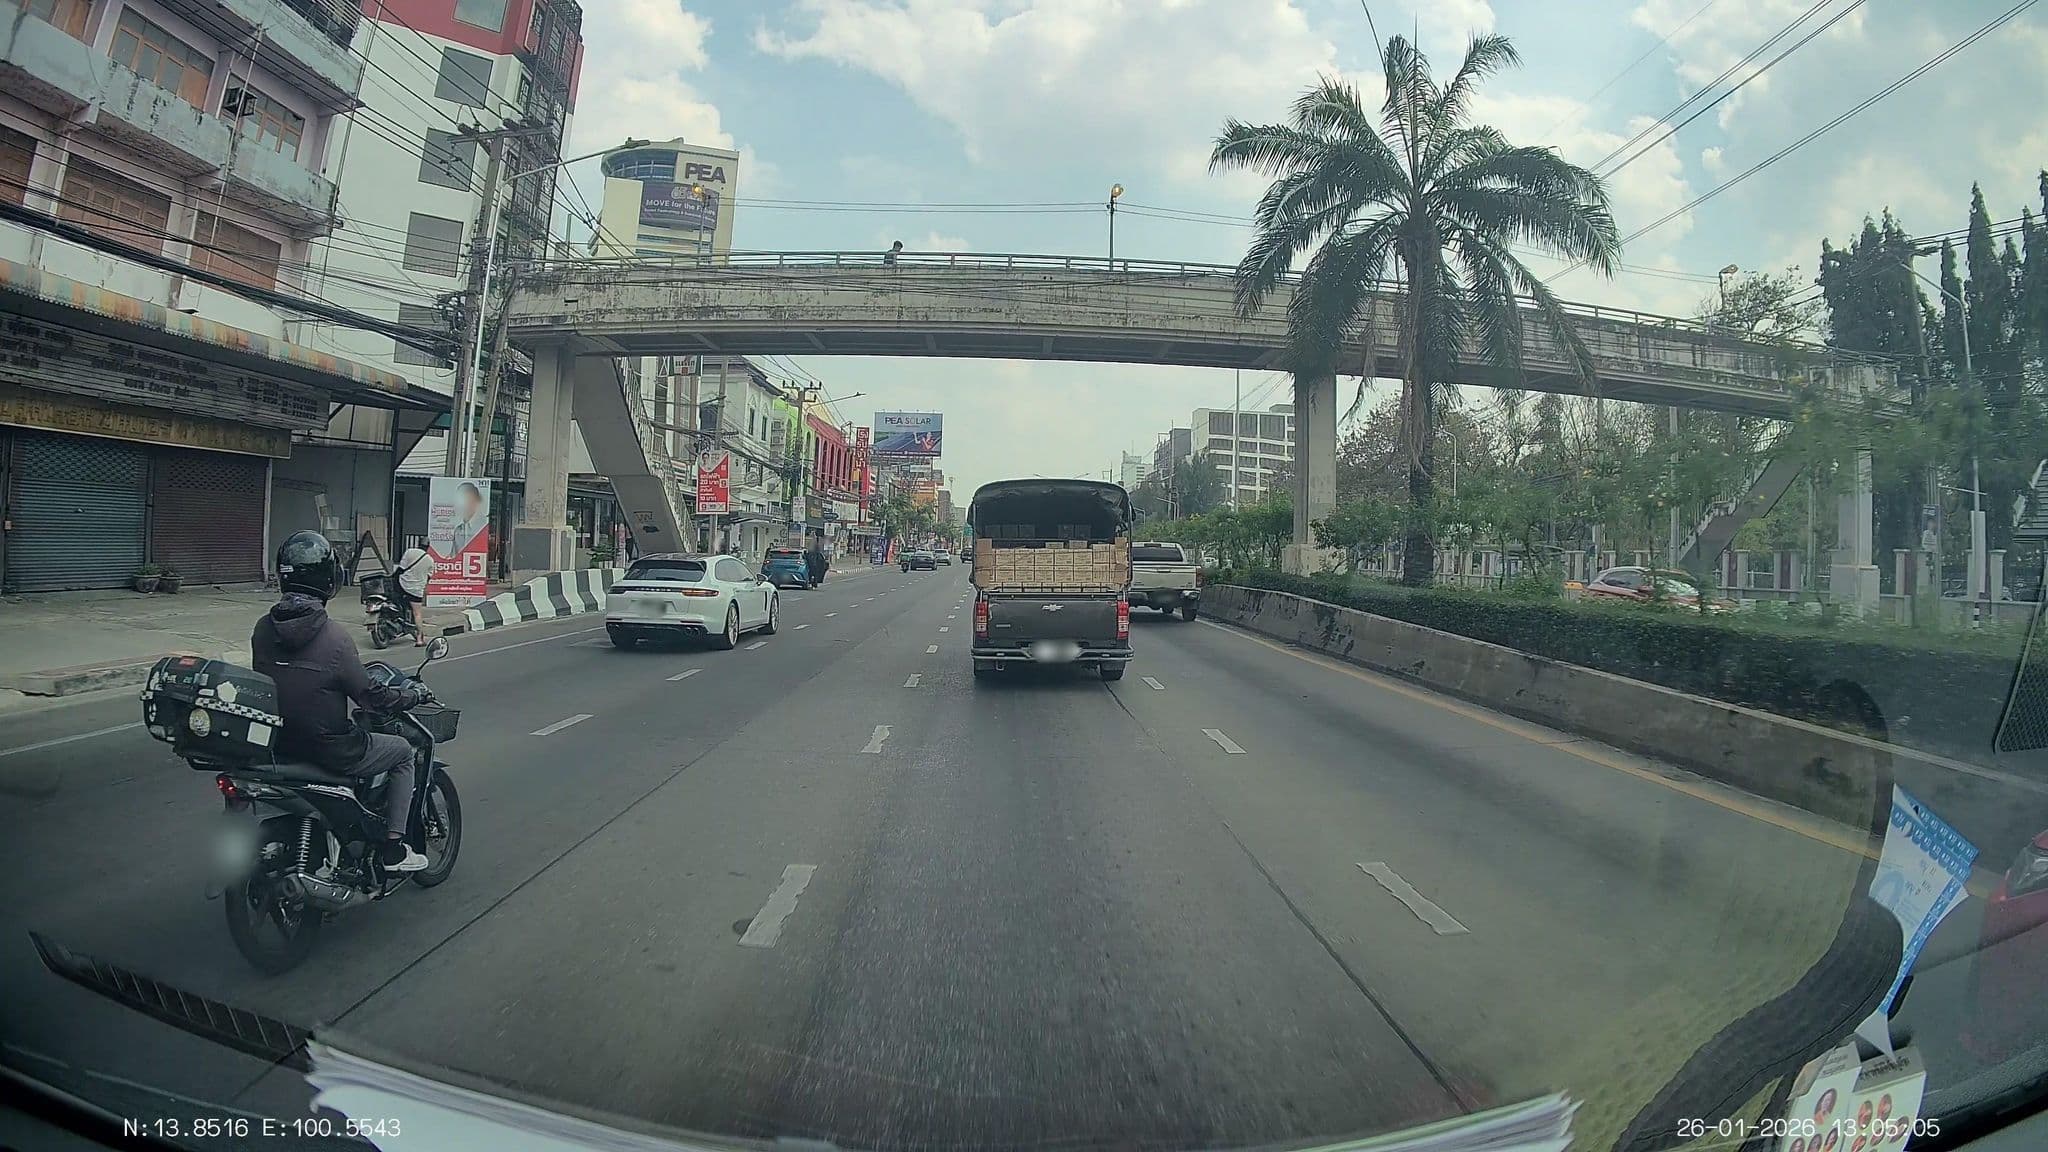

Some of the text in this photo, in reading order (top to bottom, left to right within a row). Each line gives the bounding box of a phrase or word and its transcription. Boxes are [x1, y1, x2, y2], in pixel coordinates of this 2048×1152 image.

[685, 163, 726, 184] PEA
[646, 199, 671, 207] MOVE
[684, 203, 695, 211] the
[885, 417, 931, 425] PEA SOLAR
[469, 555, 482, 575] 5
